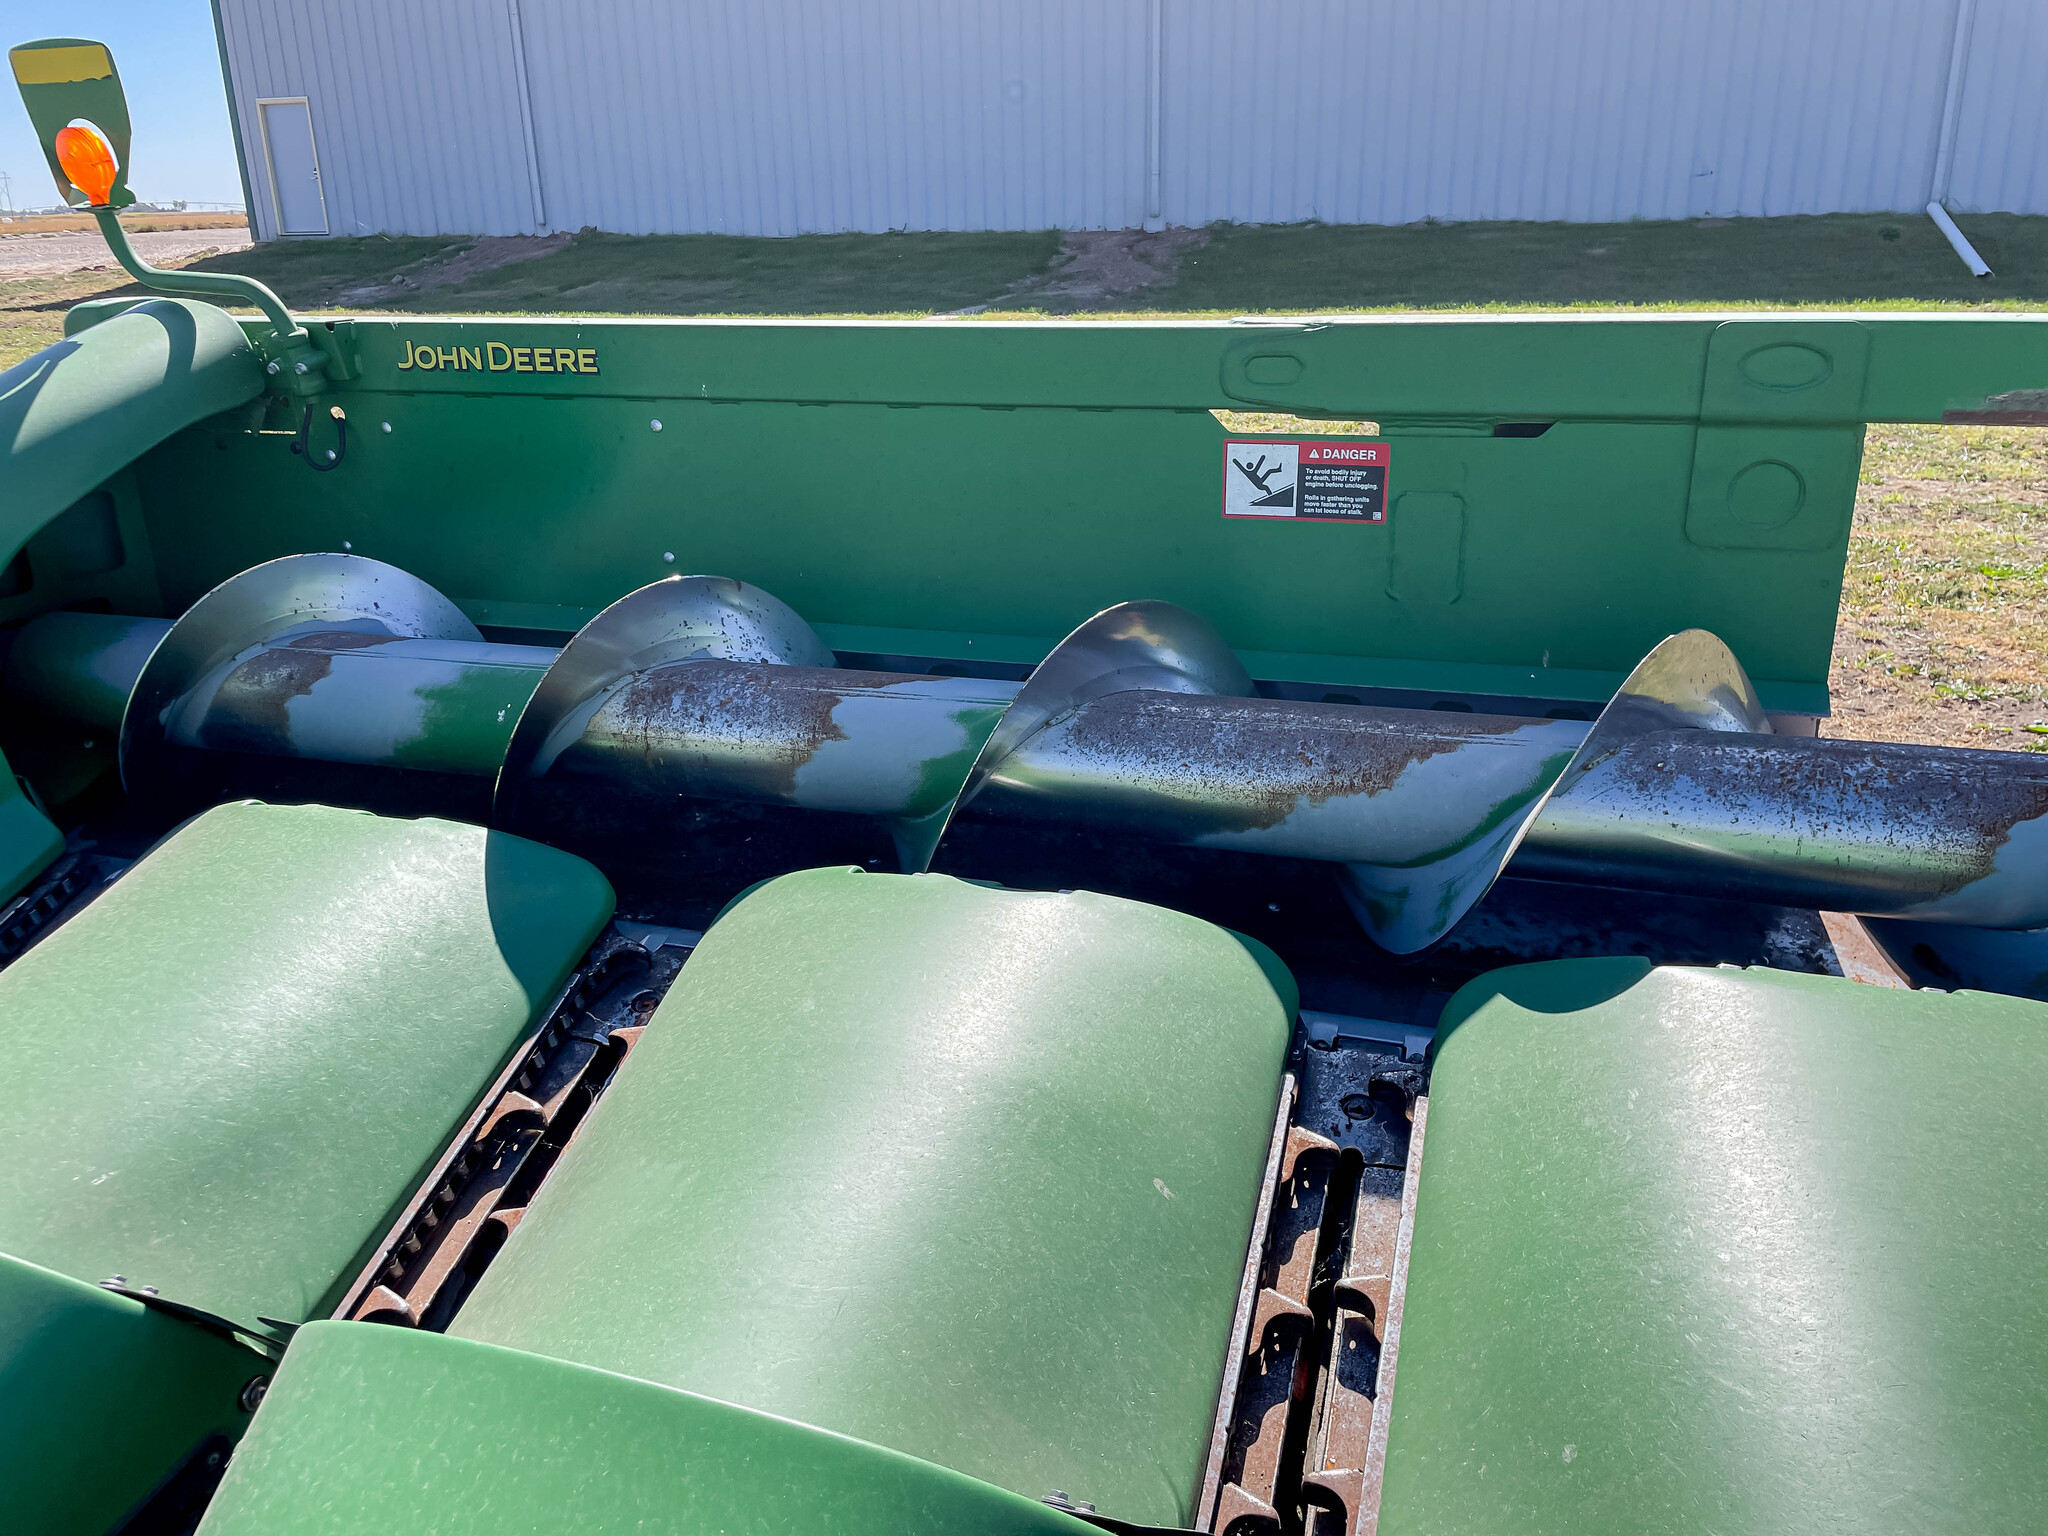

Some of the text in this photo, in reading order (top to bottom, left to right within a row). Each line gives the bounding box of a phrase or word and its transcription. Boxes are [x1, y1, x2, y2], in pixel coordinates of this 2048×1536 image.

[398, 340, 600, 374] JOHN DEERE
[1323, 449, 1377, 460] DANGER
[1327, 495, 1354, 503] gathering
